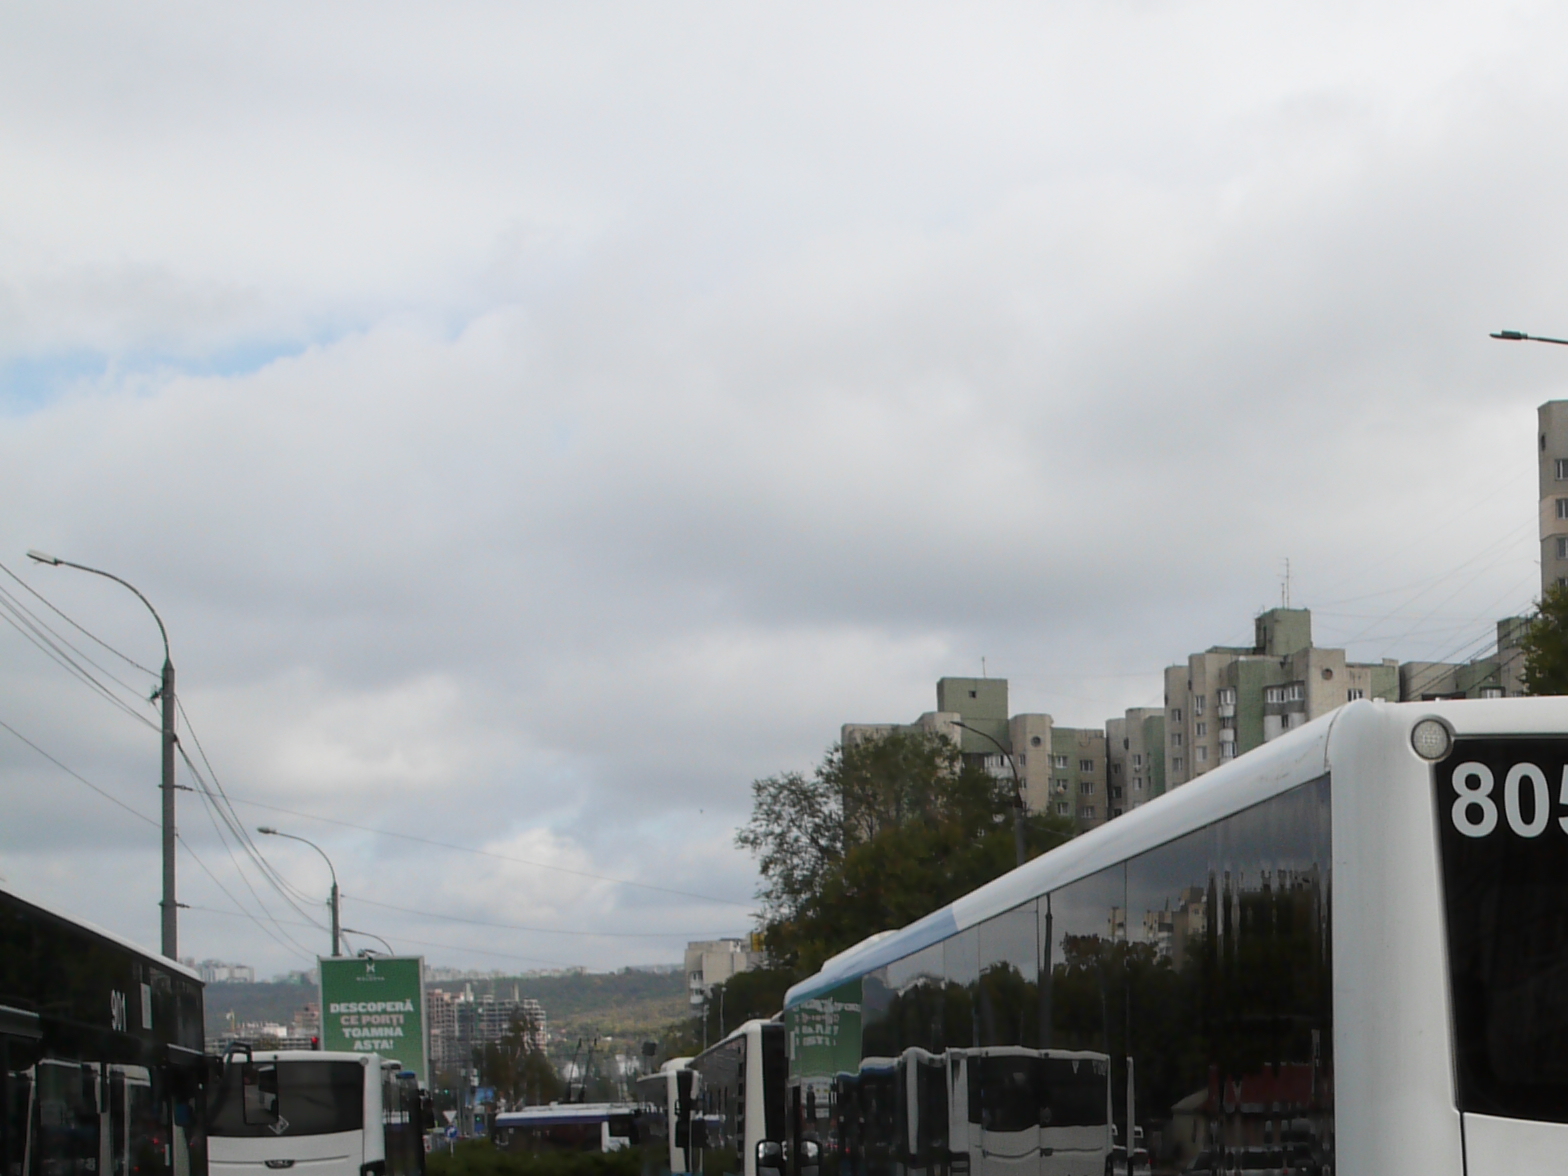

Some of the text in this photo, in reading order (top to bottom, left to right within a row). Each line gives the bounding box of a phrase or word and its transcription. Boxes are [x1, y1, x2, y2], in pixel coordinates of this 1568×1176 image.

[111, 989, 127, 1032] 901
[330, 999, 413, 1013] DESCOPERĂ
[341, 1015, 359, 1025] CE
[342, 1027, 403, 1038] TOAMNA
[354, 1039, 393, 1050] ASTA!
